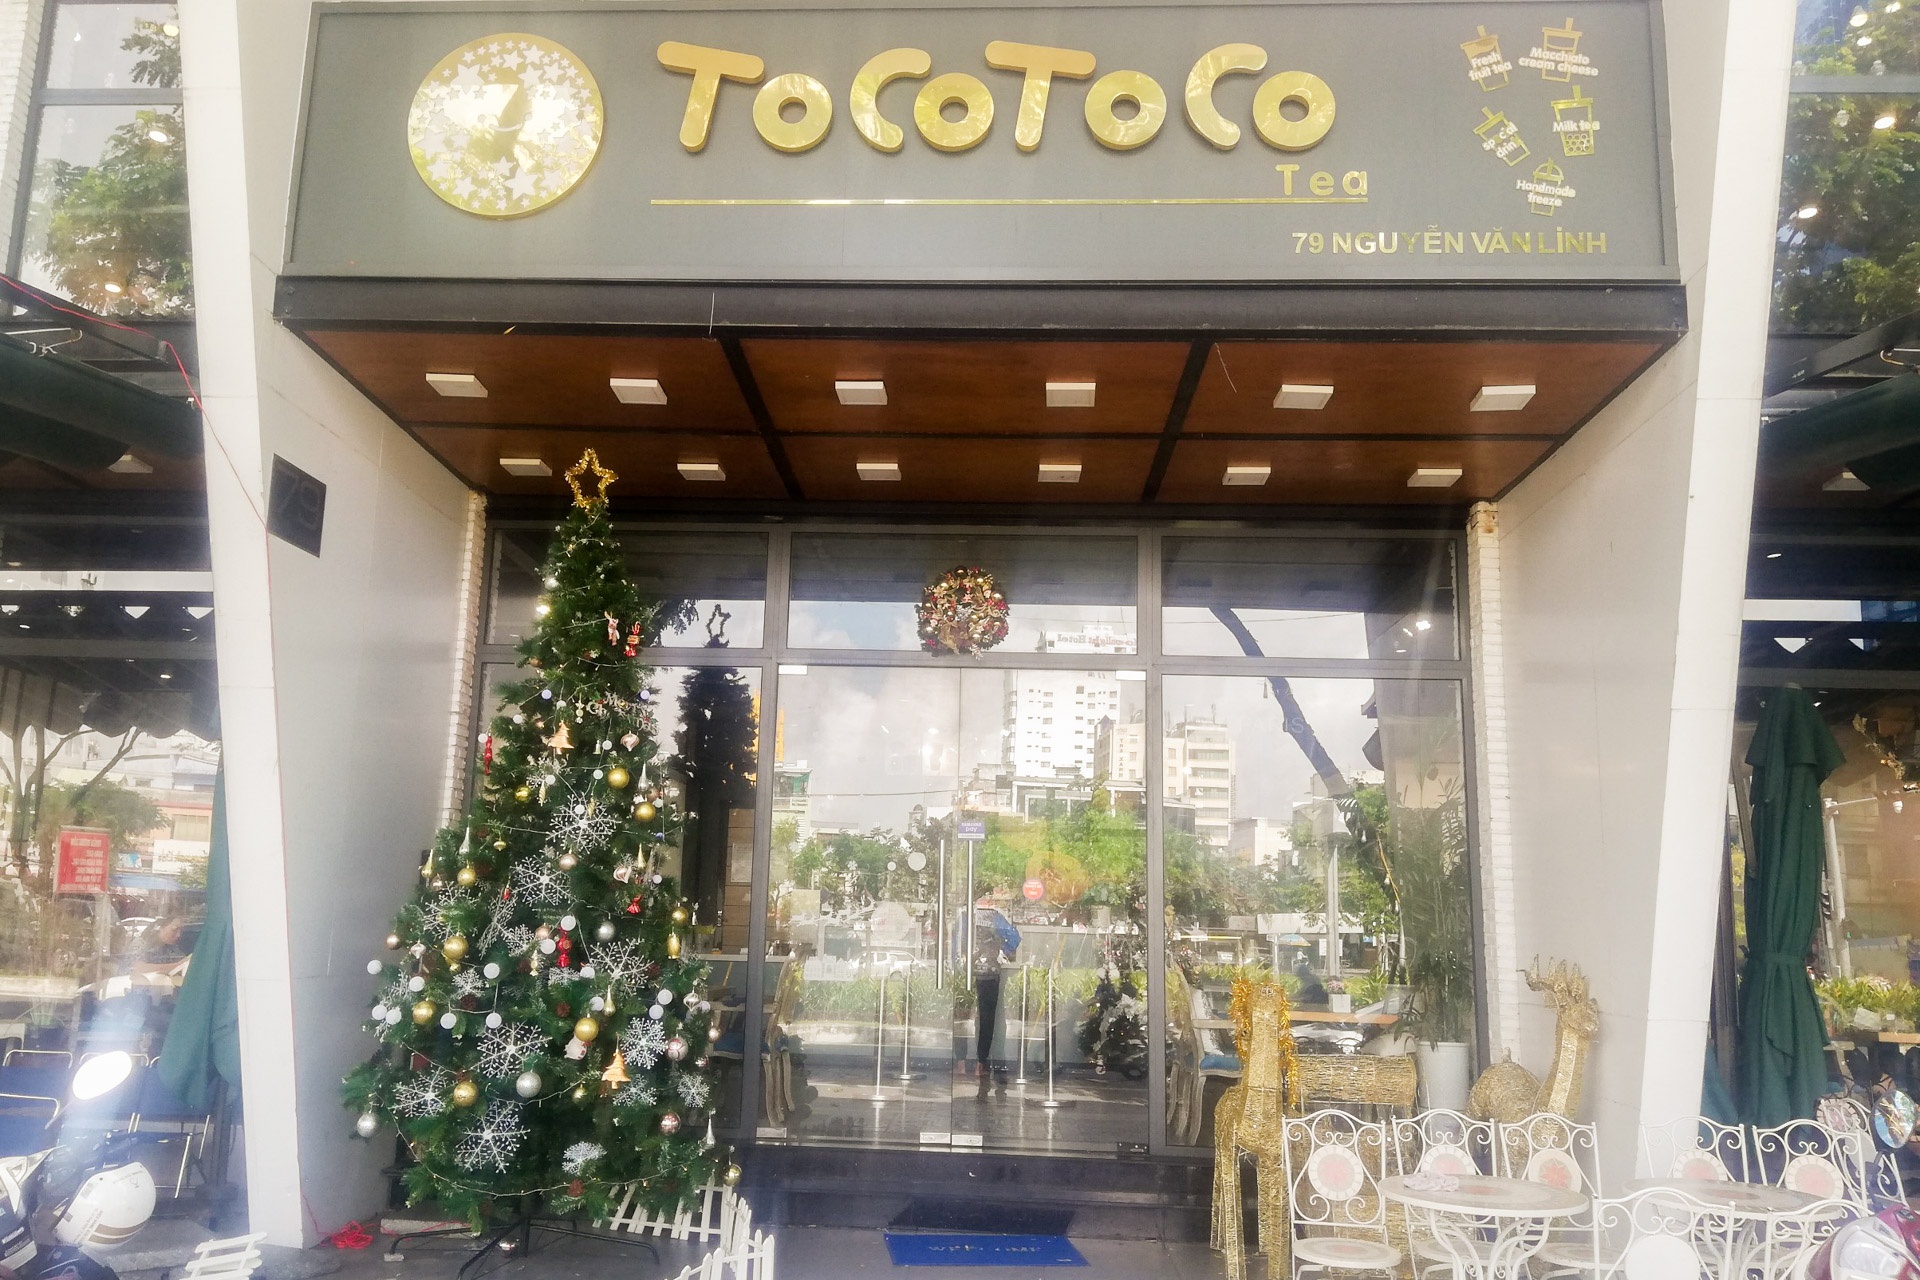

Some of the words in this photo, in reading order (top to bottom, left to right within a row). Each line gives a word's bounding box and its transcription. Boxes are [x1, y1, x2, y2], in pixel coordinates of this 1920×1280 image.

[1471, 51, 1501, 68] Fresh
[1529, 47, 1591, 65] Macchiato
[1468, 66, 1492, 81] fruit
[1492, 61, 1513, 75] tea
[1518, 56, 1556, 71] cream
[1557, 61, 1600, 77] cheese
[1481, 121, 1519, 151] spcal
[1552, 120, 1579, 133] Milk
[1579, 119, 1601, 132] tea
[1496, 137, 1520, 159] drin
[1275, 164, 1368, 197] Tea
[1516, 179, 1577, 198] Handmade
[1527, 192, 1563, 208] freeze
[1292, 231, 1325, 254] 79
[1332, 224, 1464, 255] NGUYỄN
[1470, 226, 1532, 254] VĂN
